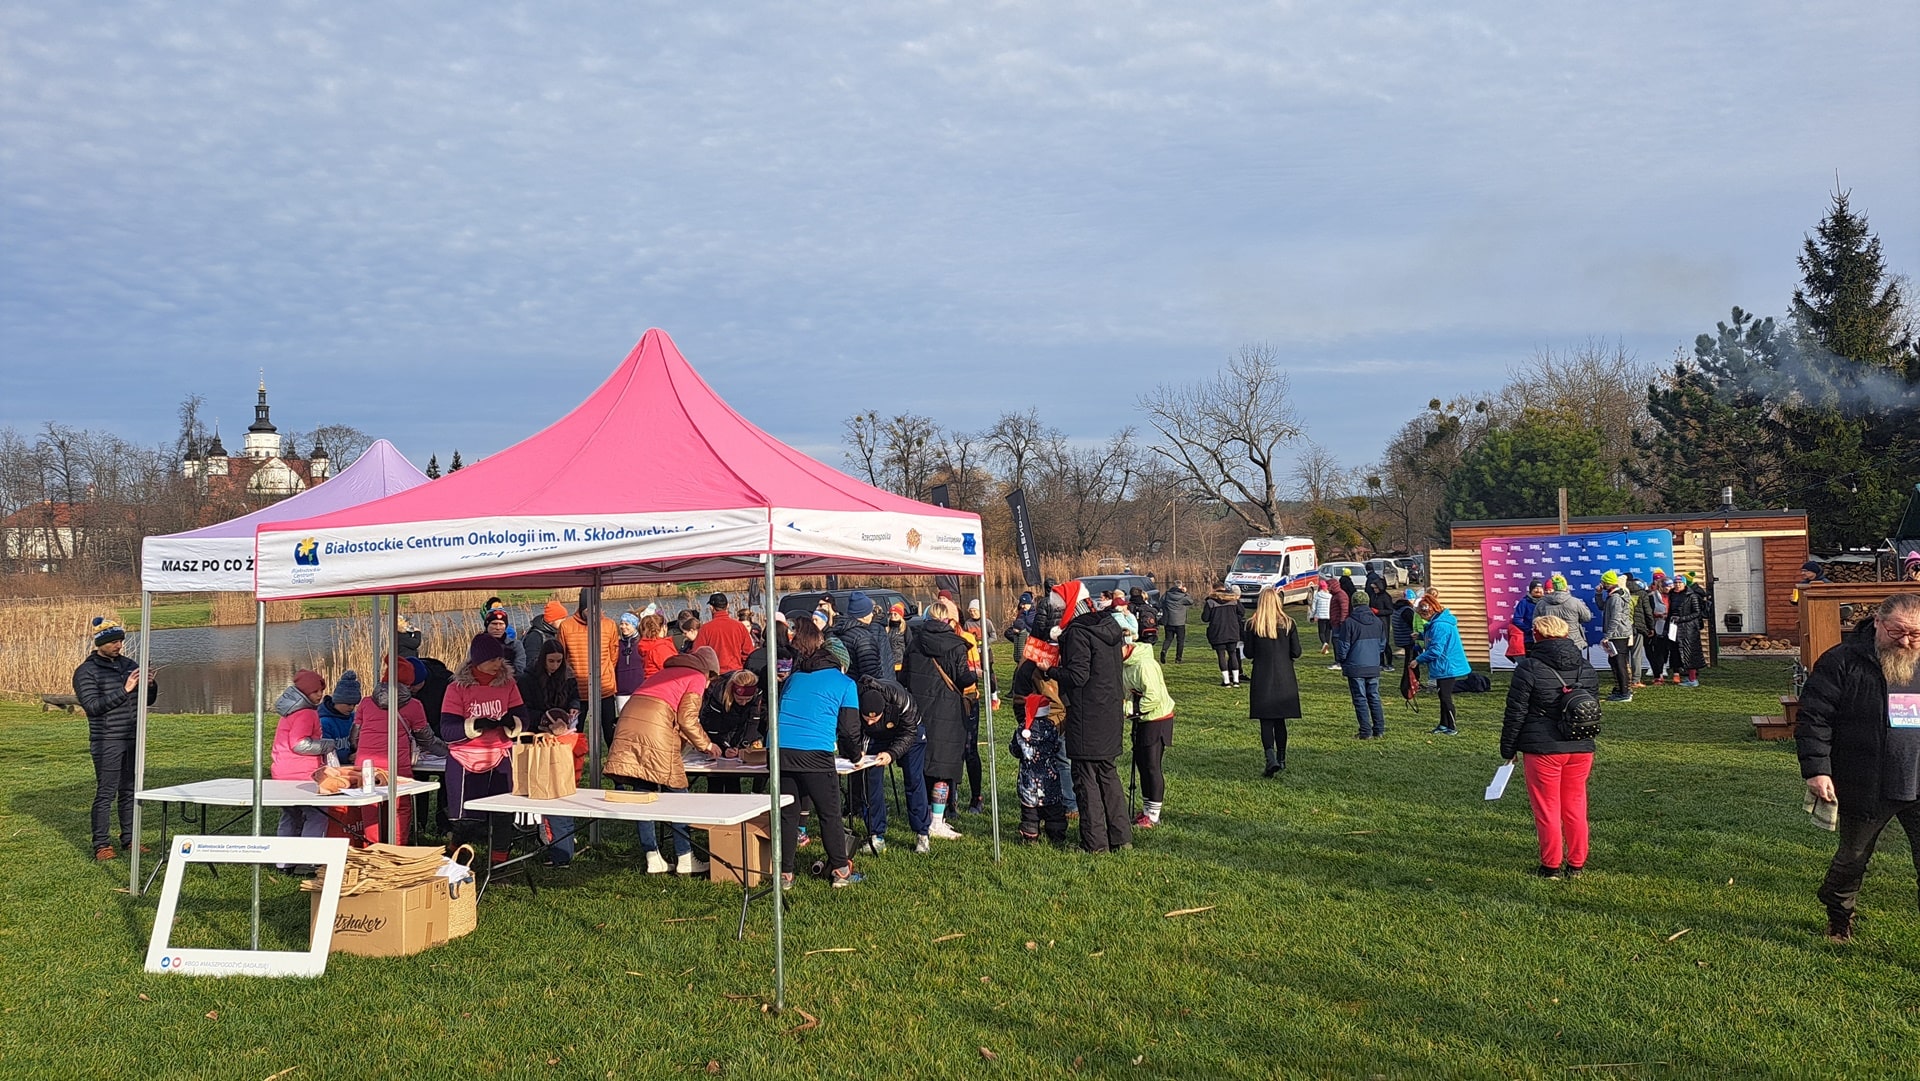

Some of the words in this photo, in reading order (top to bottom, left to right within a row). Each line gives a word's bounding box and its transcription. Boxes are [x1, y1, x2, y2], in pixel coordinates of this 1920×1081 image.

[325, 537, 404, 555] Białostockie
[406, 535, 465, 549] Centrum
[468, 529, 535, 547] Onkologii
[538, 529, 561, 543] im.
[563, 528, 580, 542] M.
[161, 559, 199, 572] MASZ
[202, 559, 220, 572] PO
[223, 559, 243, 571] CO
[473, 699, 502, 717] ONKO
